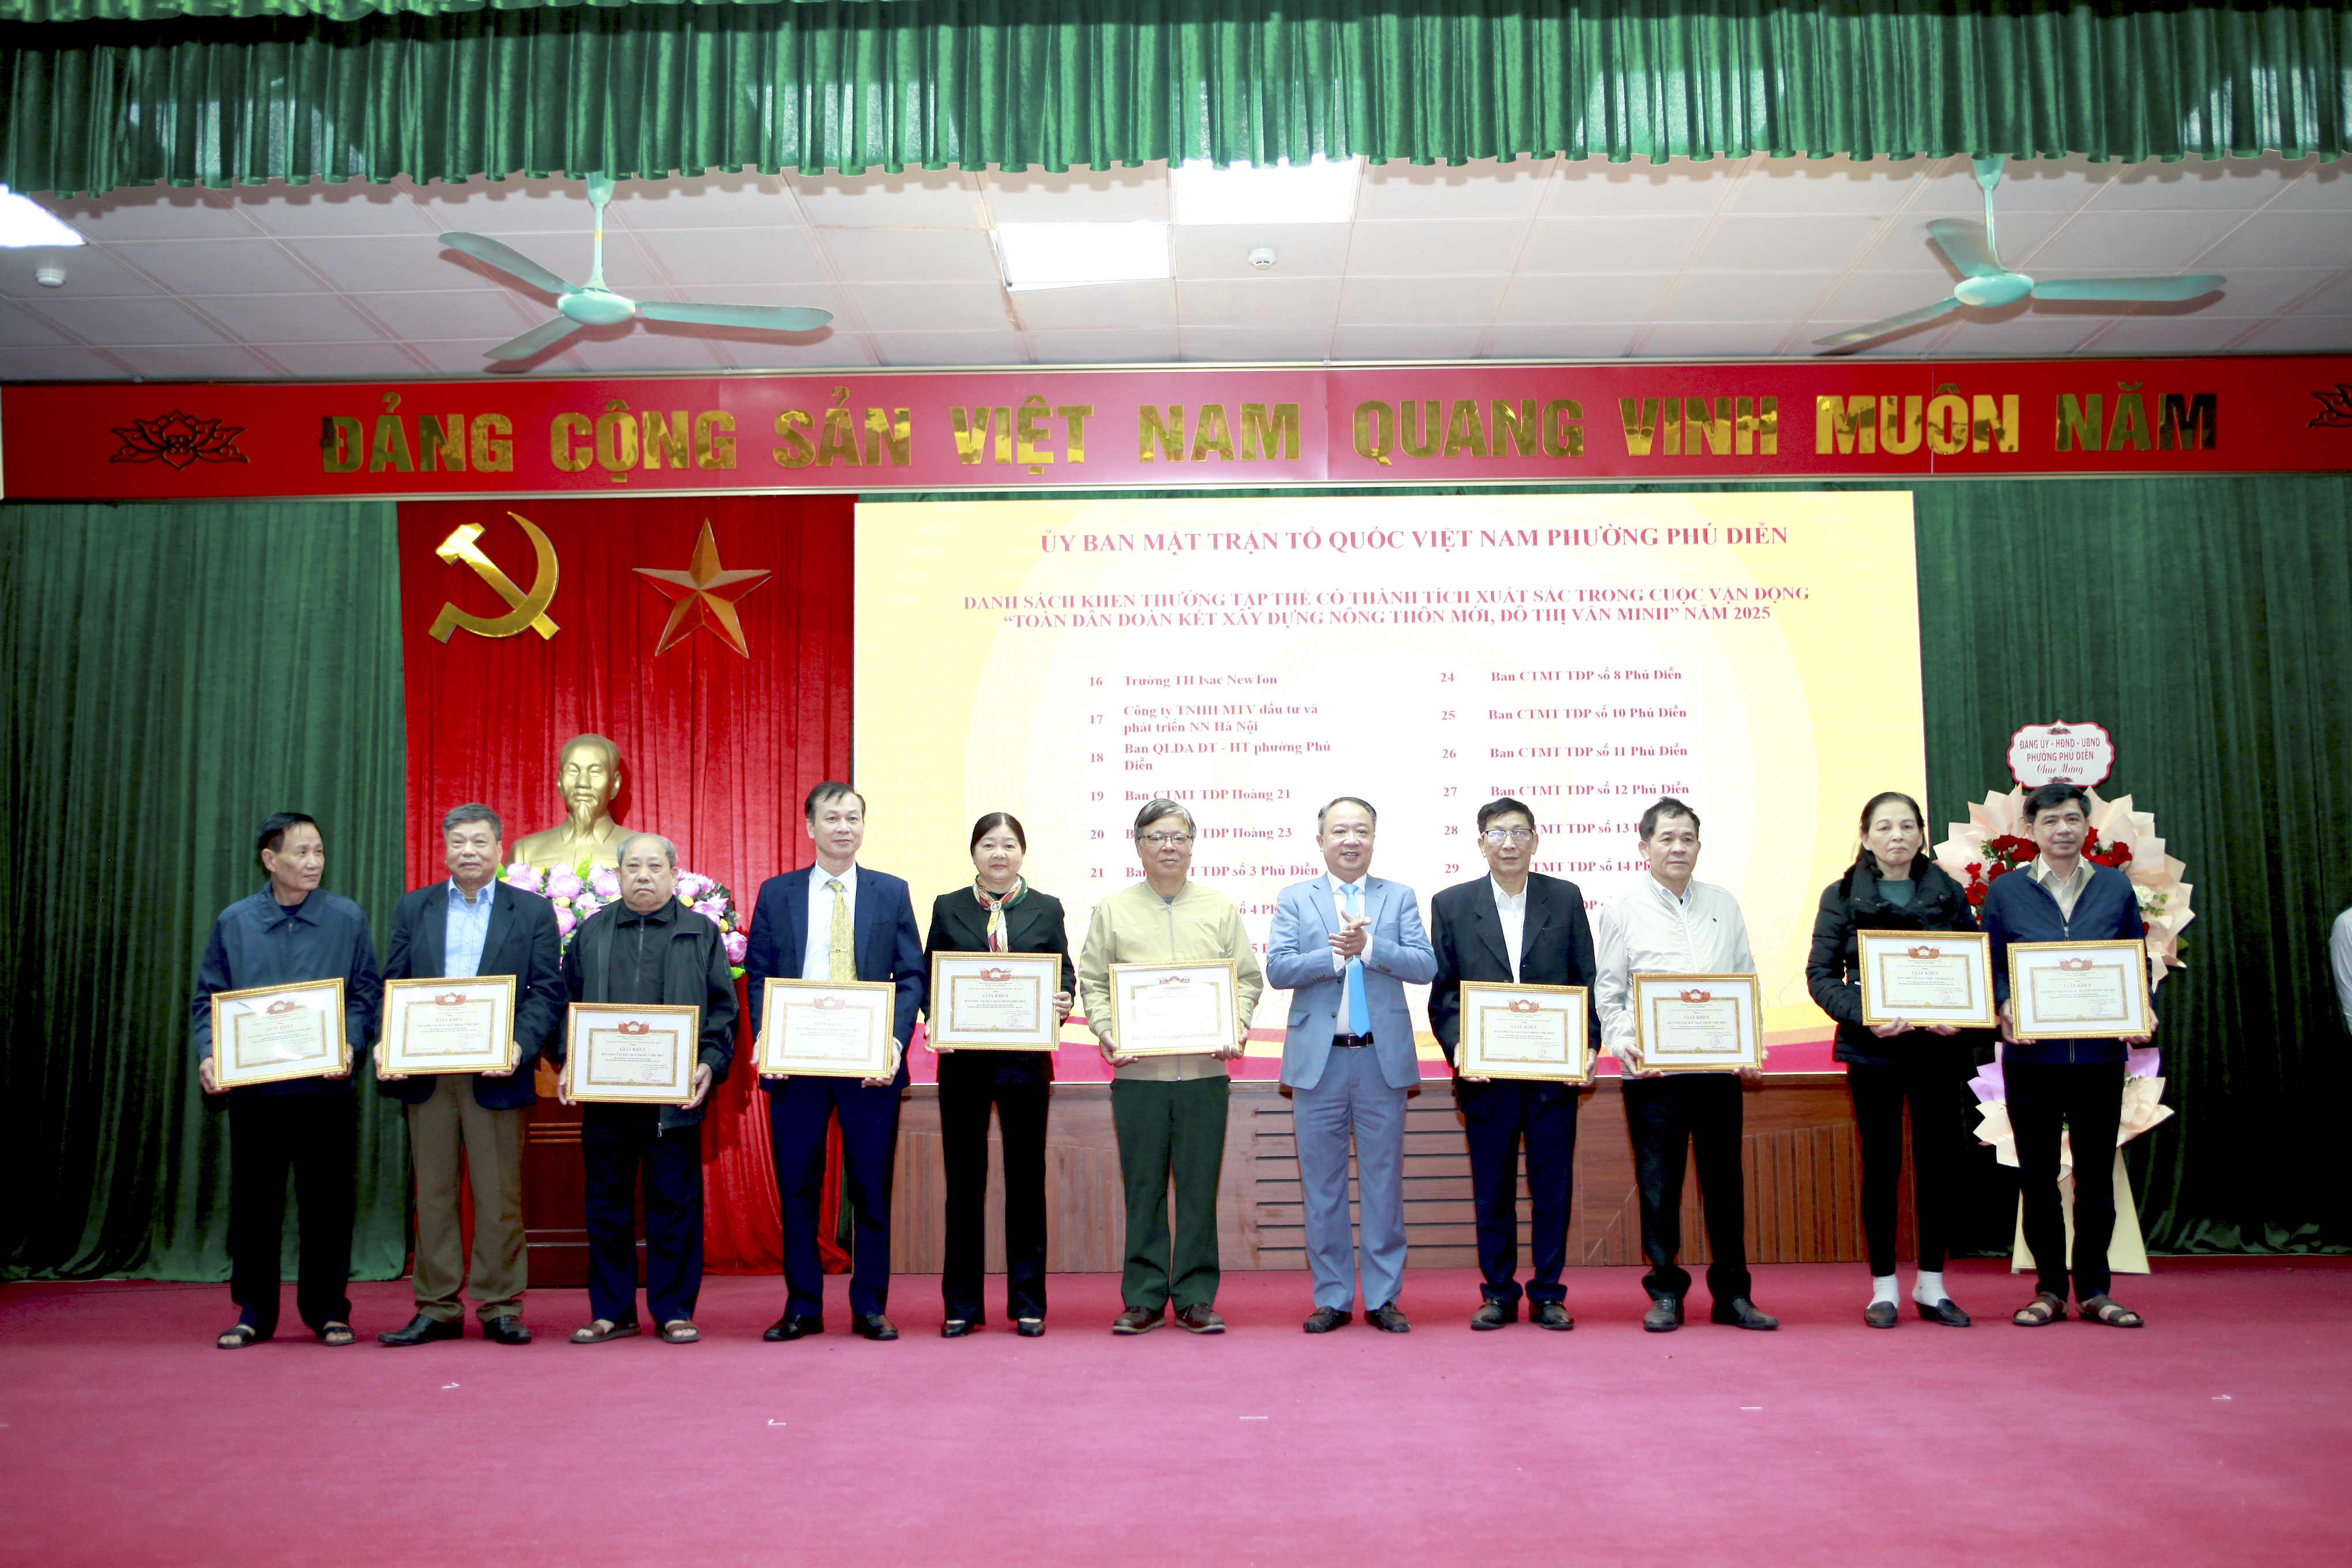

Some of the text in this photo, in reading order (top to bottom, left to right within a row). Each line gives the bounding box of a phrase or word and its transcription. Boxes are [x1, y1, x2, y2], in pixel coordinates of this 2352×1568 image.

[319, 380, 2217, 483] ĐẢNG CỘNG SẢN VIỆT NAM QUANG VINH MUÔN NĂM
[1041, 522, 1788, 556] ỦY BAN MẶT TRẬN TỔ QUỐC VIỆT NAM PHƯỜNG PHÚ DIỄN
[964, 586, 1810, 612] DANH SÁCH KHEN THƯỞNG TẬP THỂ CÓ THÀNH TÍCH XUẤT SẮC TRONG CUỘC VẬN ĐỘNG
[1004, 604, 1771, 628] “TOÀN DÂN ĐOÀN KẾT XÂY DỰNG NÔNG THÔN MỚI, ĐÔ THỊ VĂN MINH” NĂM 2025
[1440, 672, 1454, 683] 24
[1491, 666, 1682, 682] Ban CTMT TDP số 8 Phú Diễn
[1090, 676, 1103, 687] 16
[1123, 674, 1277, 689] Trường TH Isac NewTon
[1124, 700, 1318, 719] Công ty TNHH MTV đầu tư và
[1441, 710, 1456, 721] 25
[1488, 704, 1687, 720] Ban CTMT TDP số 10 Phú Diễn
[1090, 714, 1103, 725] 17
[1124, 719, 1258, 736] phát triển NN Hà Nội
[1124, 743, 1149, 753] Ban
[1152, 743, 1194, 756] QLDA
[1197, 742, 1218, 753] ĐT
[1230, 742, 1250, 753] HT
[1254, 742, 1302, 756] phường
[1306, 741, 1330, 752] Phú
[1490, 742, 1688, 758] Ban CTMT TDP số 11 Phú Diễn
[2056, 738, 2075, 748] HĐND
[2082, 738, 2100, 747] UBND
[1090, 752, 1104, 763] 18
[1442, 748, 1457, 759] 26
[2027, 750, 2057, 762] PHƯỜNG
[2060, 749, 2074, 760] PHÚ
[1124, 757, 1153, 771] Diễn
[1090, 791, 1104, 801] 19
[1125, 789, 1290, 802] Ban CTMT TDP Hoàng 21
[1443, 786, 1457, 797] 27
[1490, 781, 1689, 797] Ban CTMT TDP số 12 Phú Diễn
[1201, 827, 1292, 841] TDP Hoàng 23
[1443, 825, 1458, 835] 28
[1566, 823, 1595, 834] TDP
[1598, 820, 1612, 834] số
[1615, 823, 1630, 834] 13
[1090, 830, 1105, 840] 20
[1201, 866, 1230, 877] TDP
[1232, 862, 1246, 876] số
[1249, 865, 1257, 876] 3
[1260, 865, 1286, 876] Phú
[1290, 862, 1318, 876] Diễn
[1445, 863, 1460, 874] 29
[1567, 857, 1630, 872] TDP số 14
[1090, 867, 1104, 878] 21
[1250, 904, 1258, 915] 4
